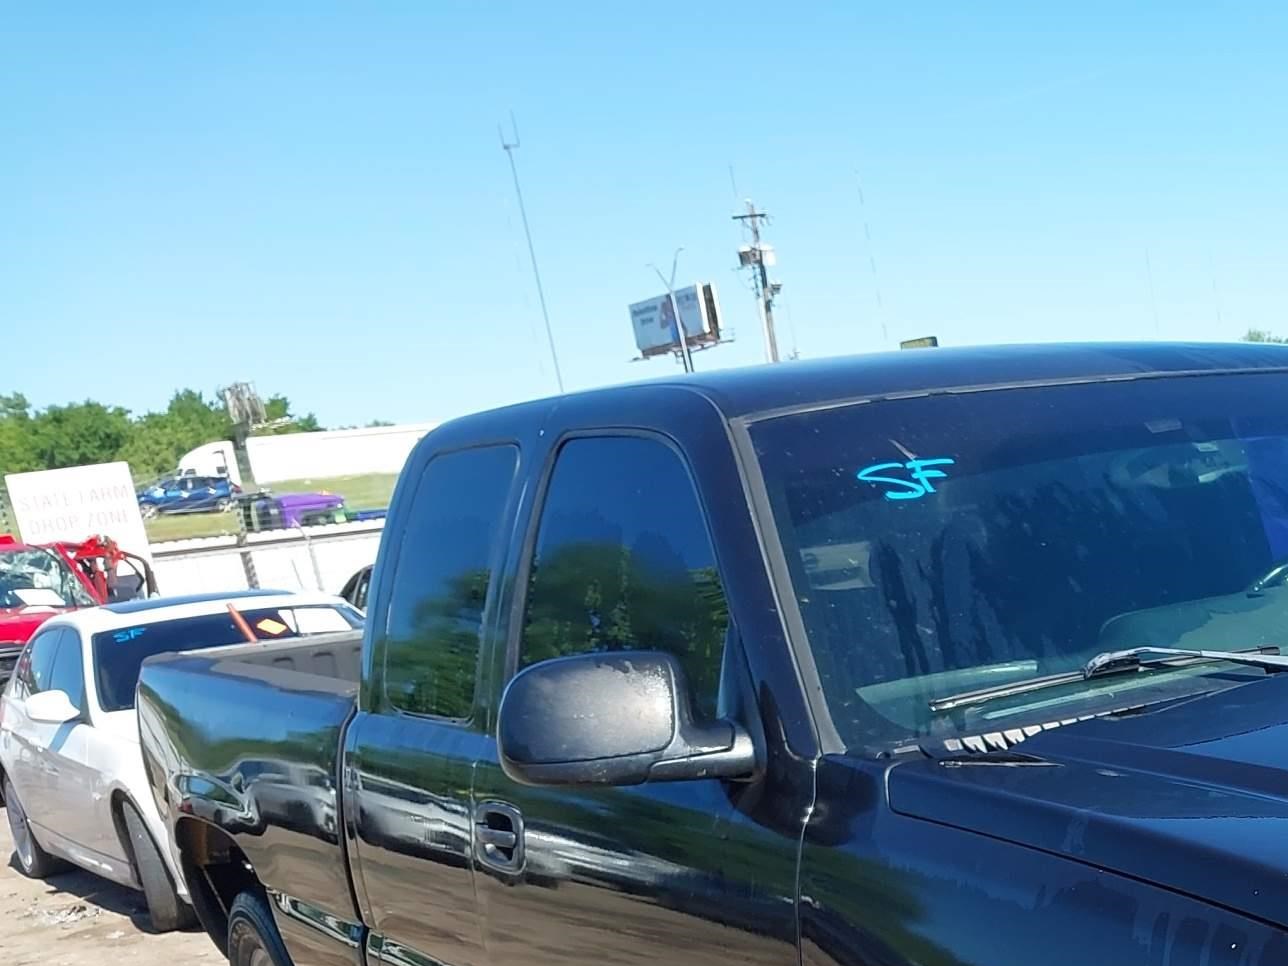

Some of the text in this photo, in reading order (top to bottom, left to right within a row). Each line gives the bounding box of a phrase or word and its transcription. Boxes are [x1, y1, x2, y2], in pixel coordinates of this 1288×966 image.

[856, 457, 955, 500] SF
[18, 484, 129, 513] STATE FARM
[30, 514, 80, 535] DROP
[112, 627, 147, 643] SF
